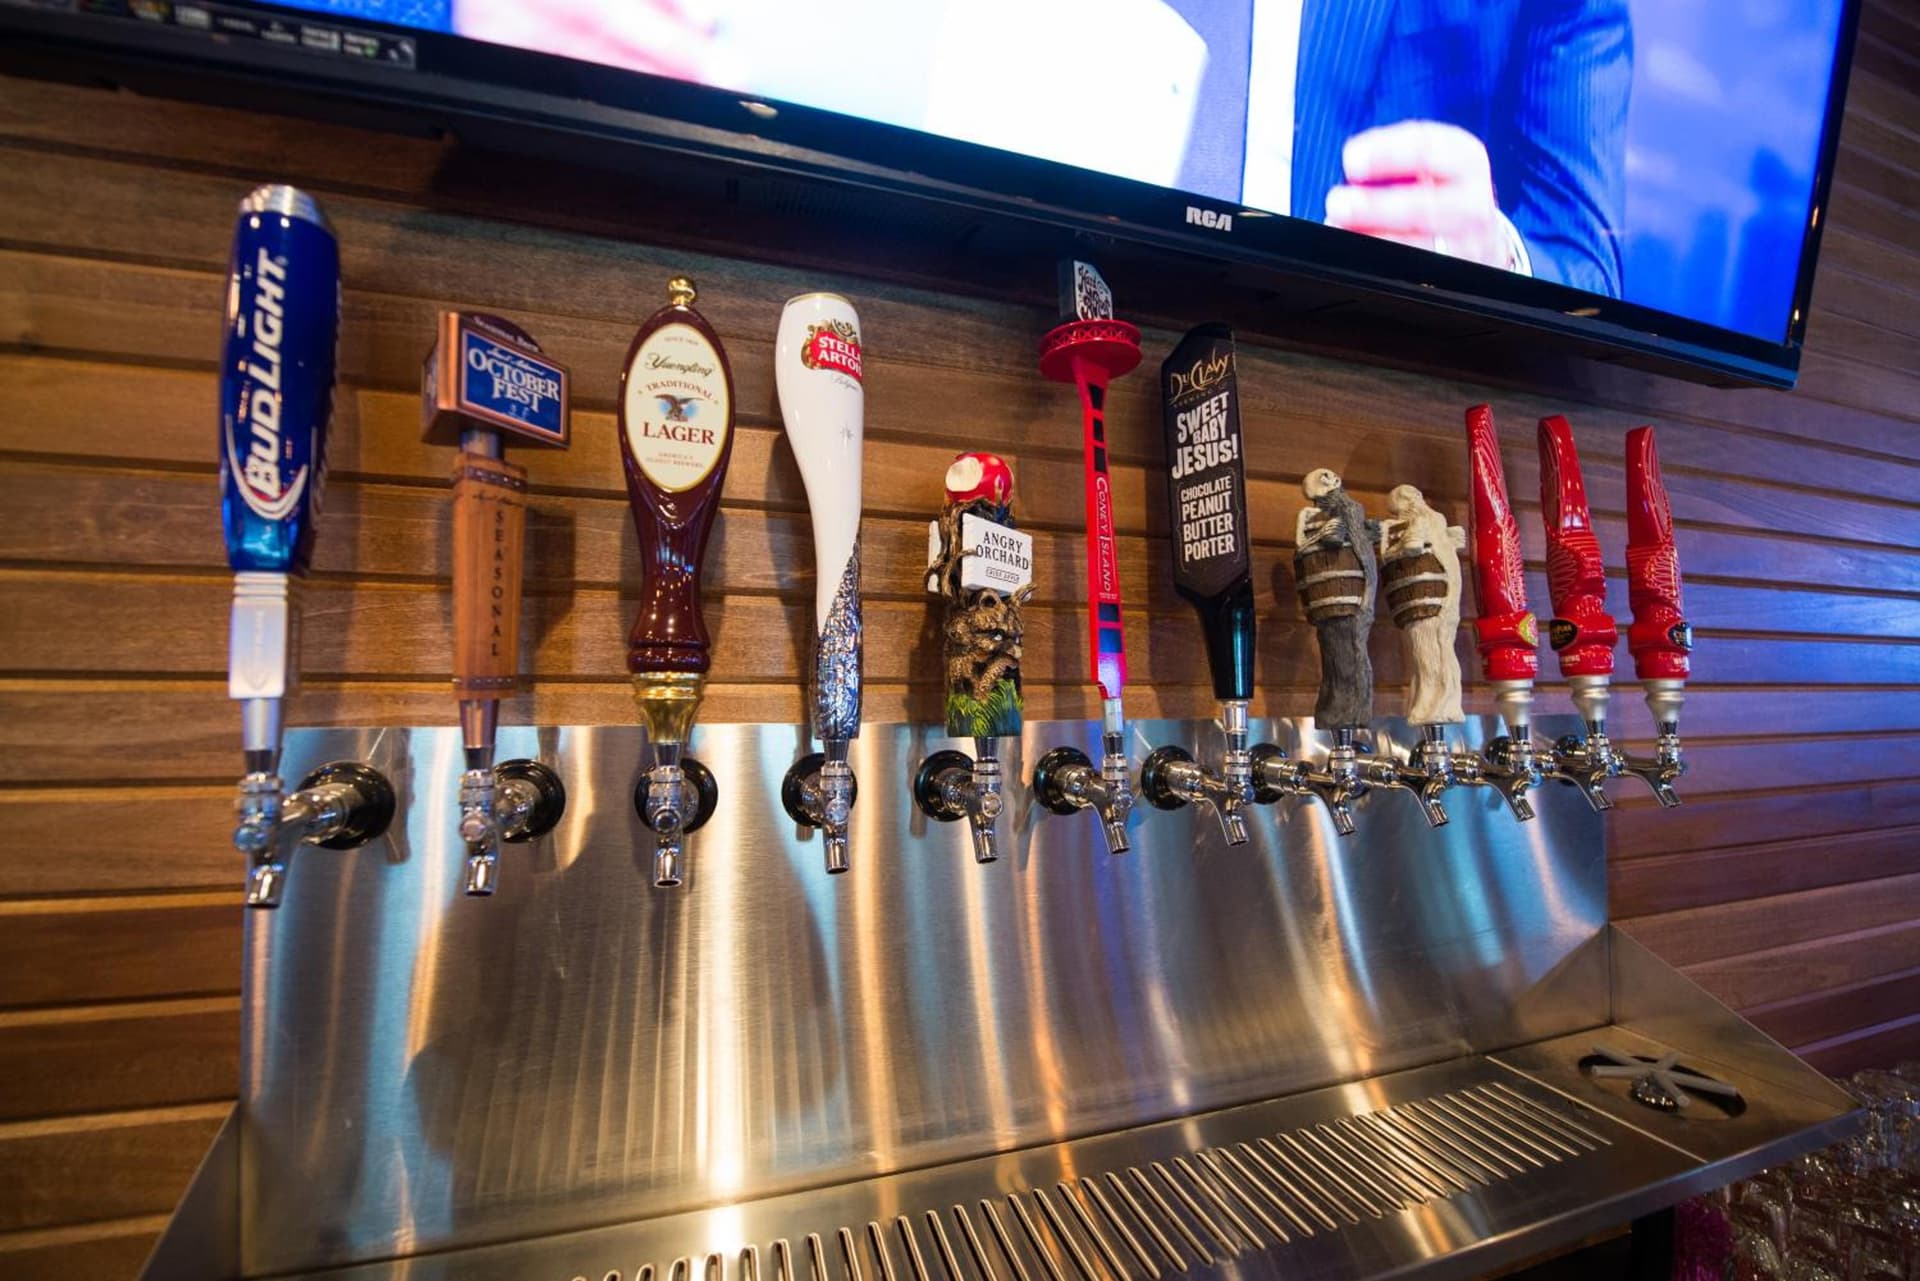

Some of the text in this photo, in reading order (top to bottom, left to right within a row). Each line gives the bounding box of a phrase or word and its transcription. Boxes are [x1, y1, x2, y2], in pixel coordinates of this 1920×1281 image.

[1186, 206, 1233, 232] RCA
[246, 248, 287, 500] BUD LIGHT
[468, 347, 560, 401] OCTOBER
[492, 377, 541, 413] FEST
[646, 379, 714, 402] TRADITIONAL
[1177, 391, 1230, 444] SWEET
[1193, 410, 1228, 445] BABY
[642, 421, 715, 446] LAGER
[1171, 433, 1239, 479] JESUS!
[1180, 475, 1232, 502] CHOCOLATE
[1182, 491, 1232, 522] PEANUT
[1183, 512, 1234, 542] BUTTER
[975, 544, 1029, 571] ORCHARD
[983, 531, 1023, 554] ANGRY
[1184, 533, 1235, 562] PORTER
[491, 510, 504, 657] SEASONAL
